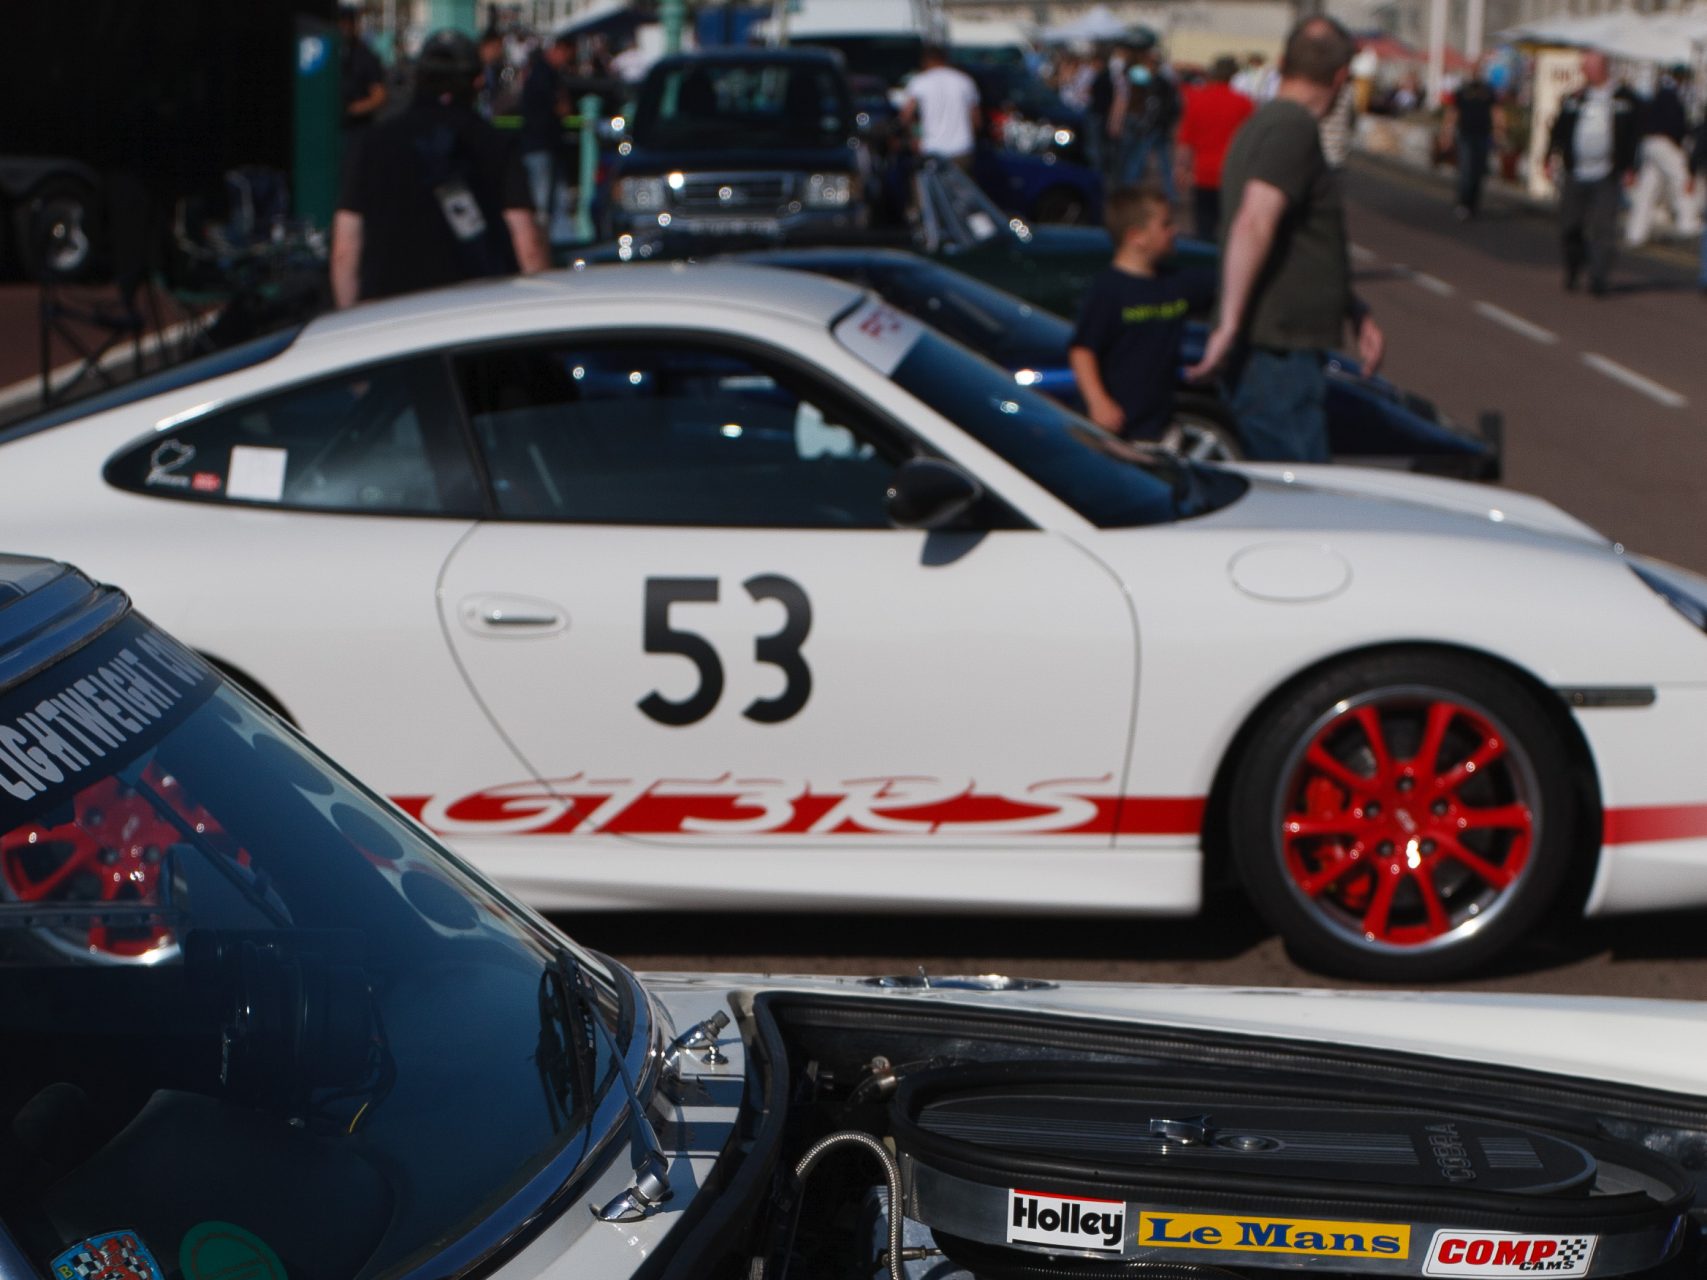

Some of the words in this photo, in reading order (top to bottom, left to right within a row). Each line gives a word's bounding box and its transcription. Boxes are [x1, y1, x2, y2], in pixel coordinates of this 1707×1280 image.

[636, 572, 813, 728] 53
[1013, 1196, 1123, 1247] Holley
[1146, 1217, 1223, 1245] Le
[1234, 1221, 1401, 1254] Mans
[1437, 1238, 1558, 1266] COMP
[1518, 1260, 1575, 1271] CAMS
